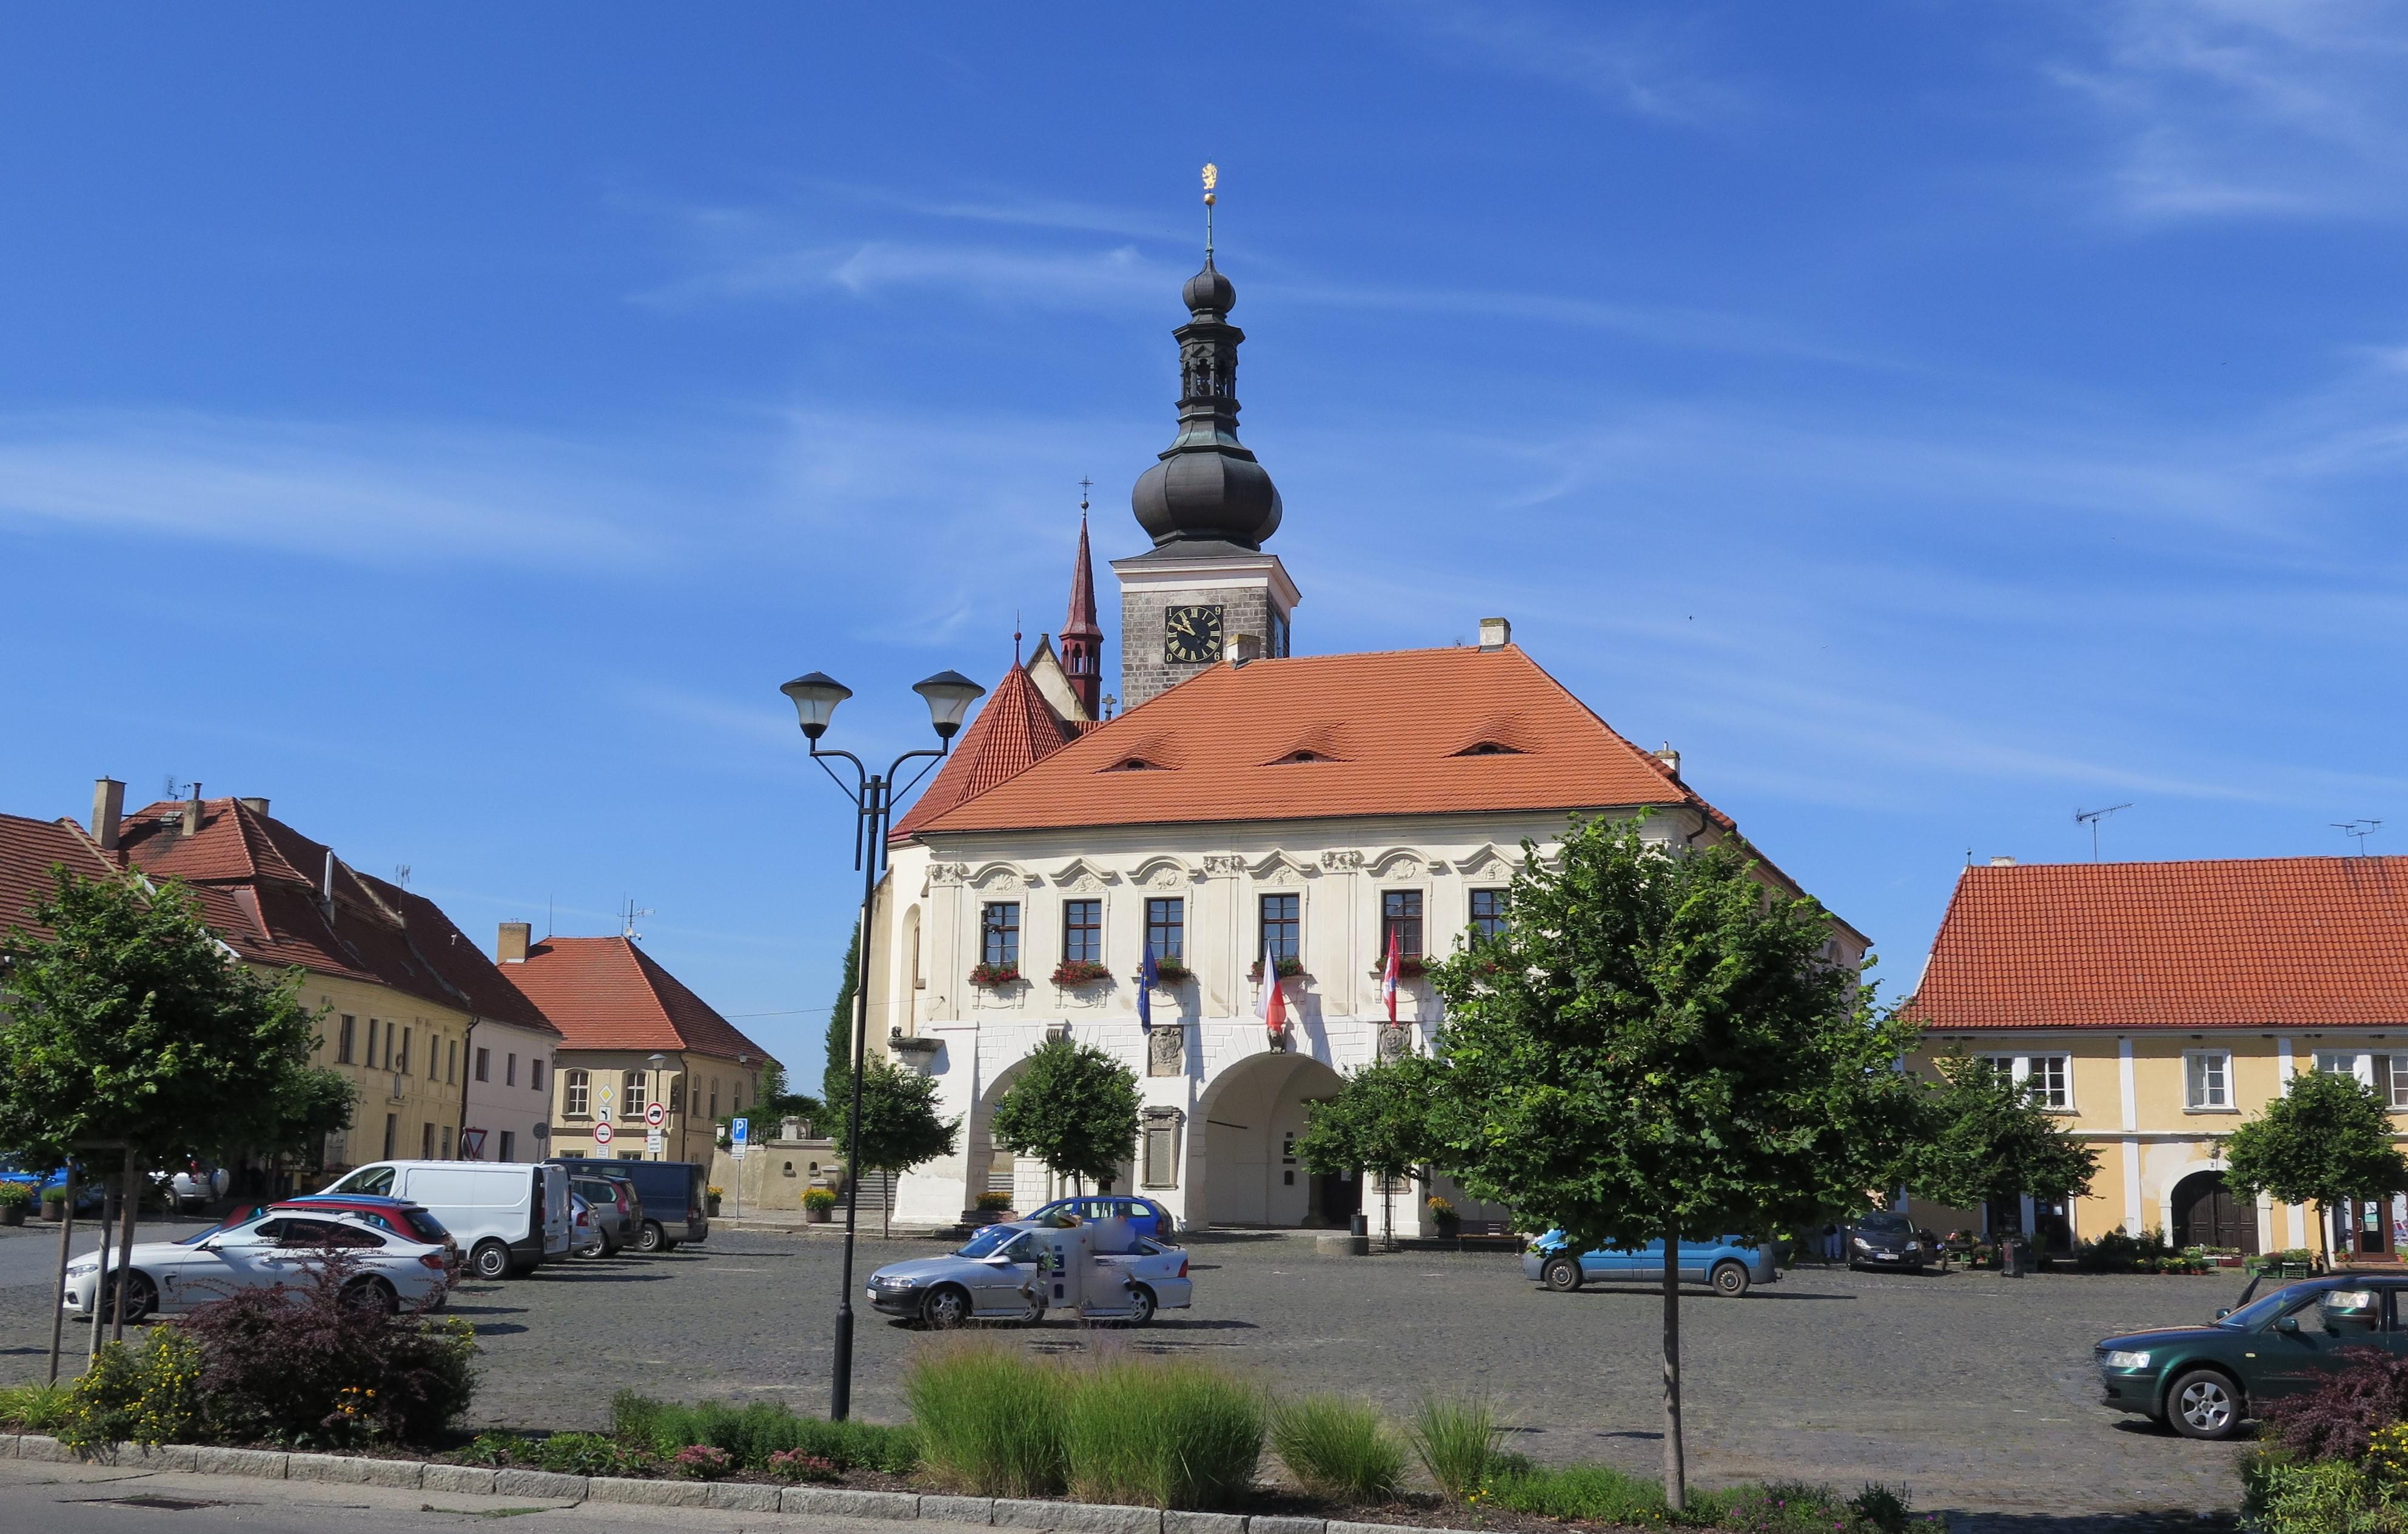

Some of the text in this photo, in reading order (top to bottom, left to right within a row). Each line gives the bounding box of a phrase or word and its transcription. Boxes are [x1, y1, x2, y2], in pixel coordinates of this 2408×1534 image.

[1169, 608, 1172, 617] 1
[1215, 606, 1221, 615] 9
[1167, 653, 1172, 661] 0
[1214, 652, 1220, 660] 6
[736, 1120, 744, 1135] P
